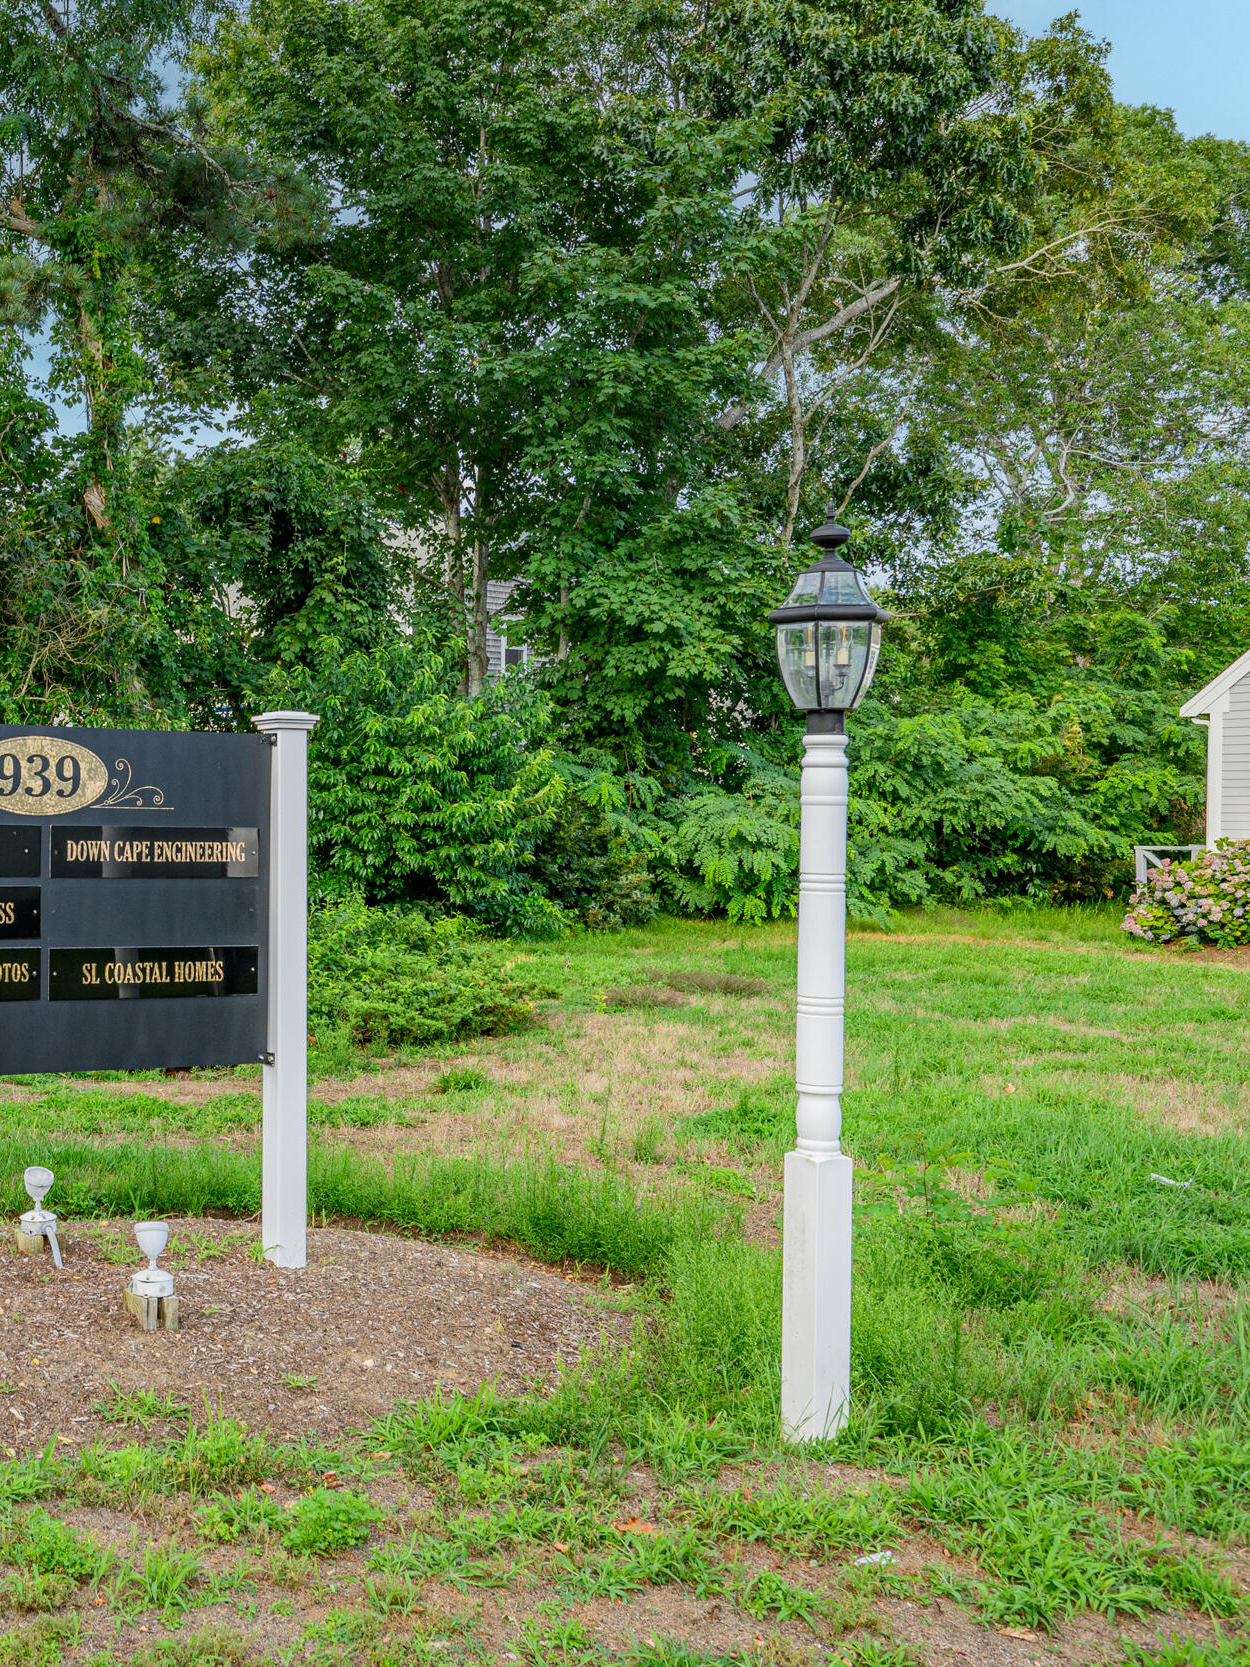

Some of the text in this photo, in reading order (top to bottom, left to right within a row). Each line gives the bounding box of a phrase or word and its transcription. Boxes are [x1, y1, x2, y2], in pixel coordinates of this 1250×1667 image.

[66, 840, 246, 863] DOWN CAPE ENGINEERING
[82, 960, 224, 985] SL COASTAL HOMES
